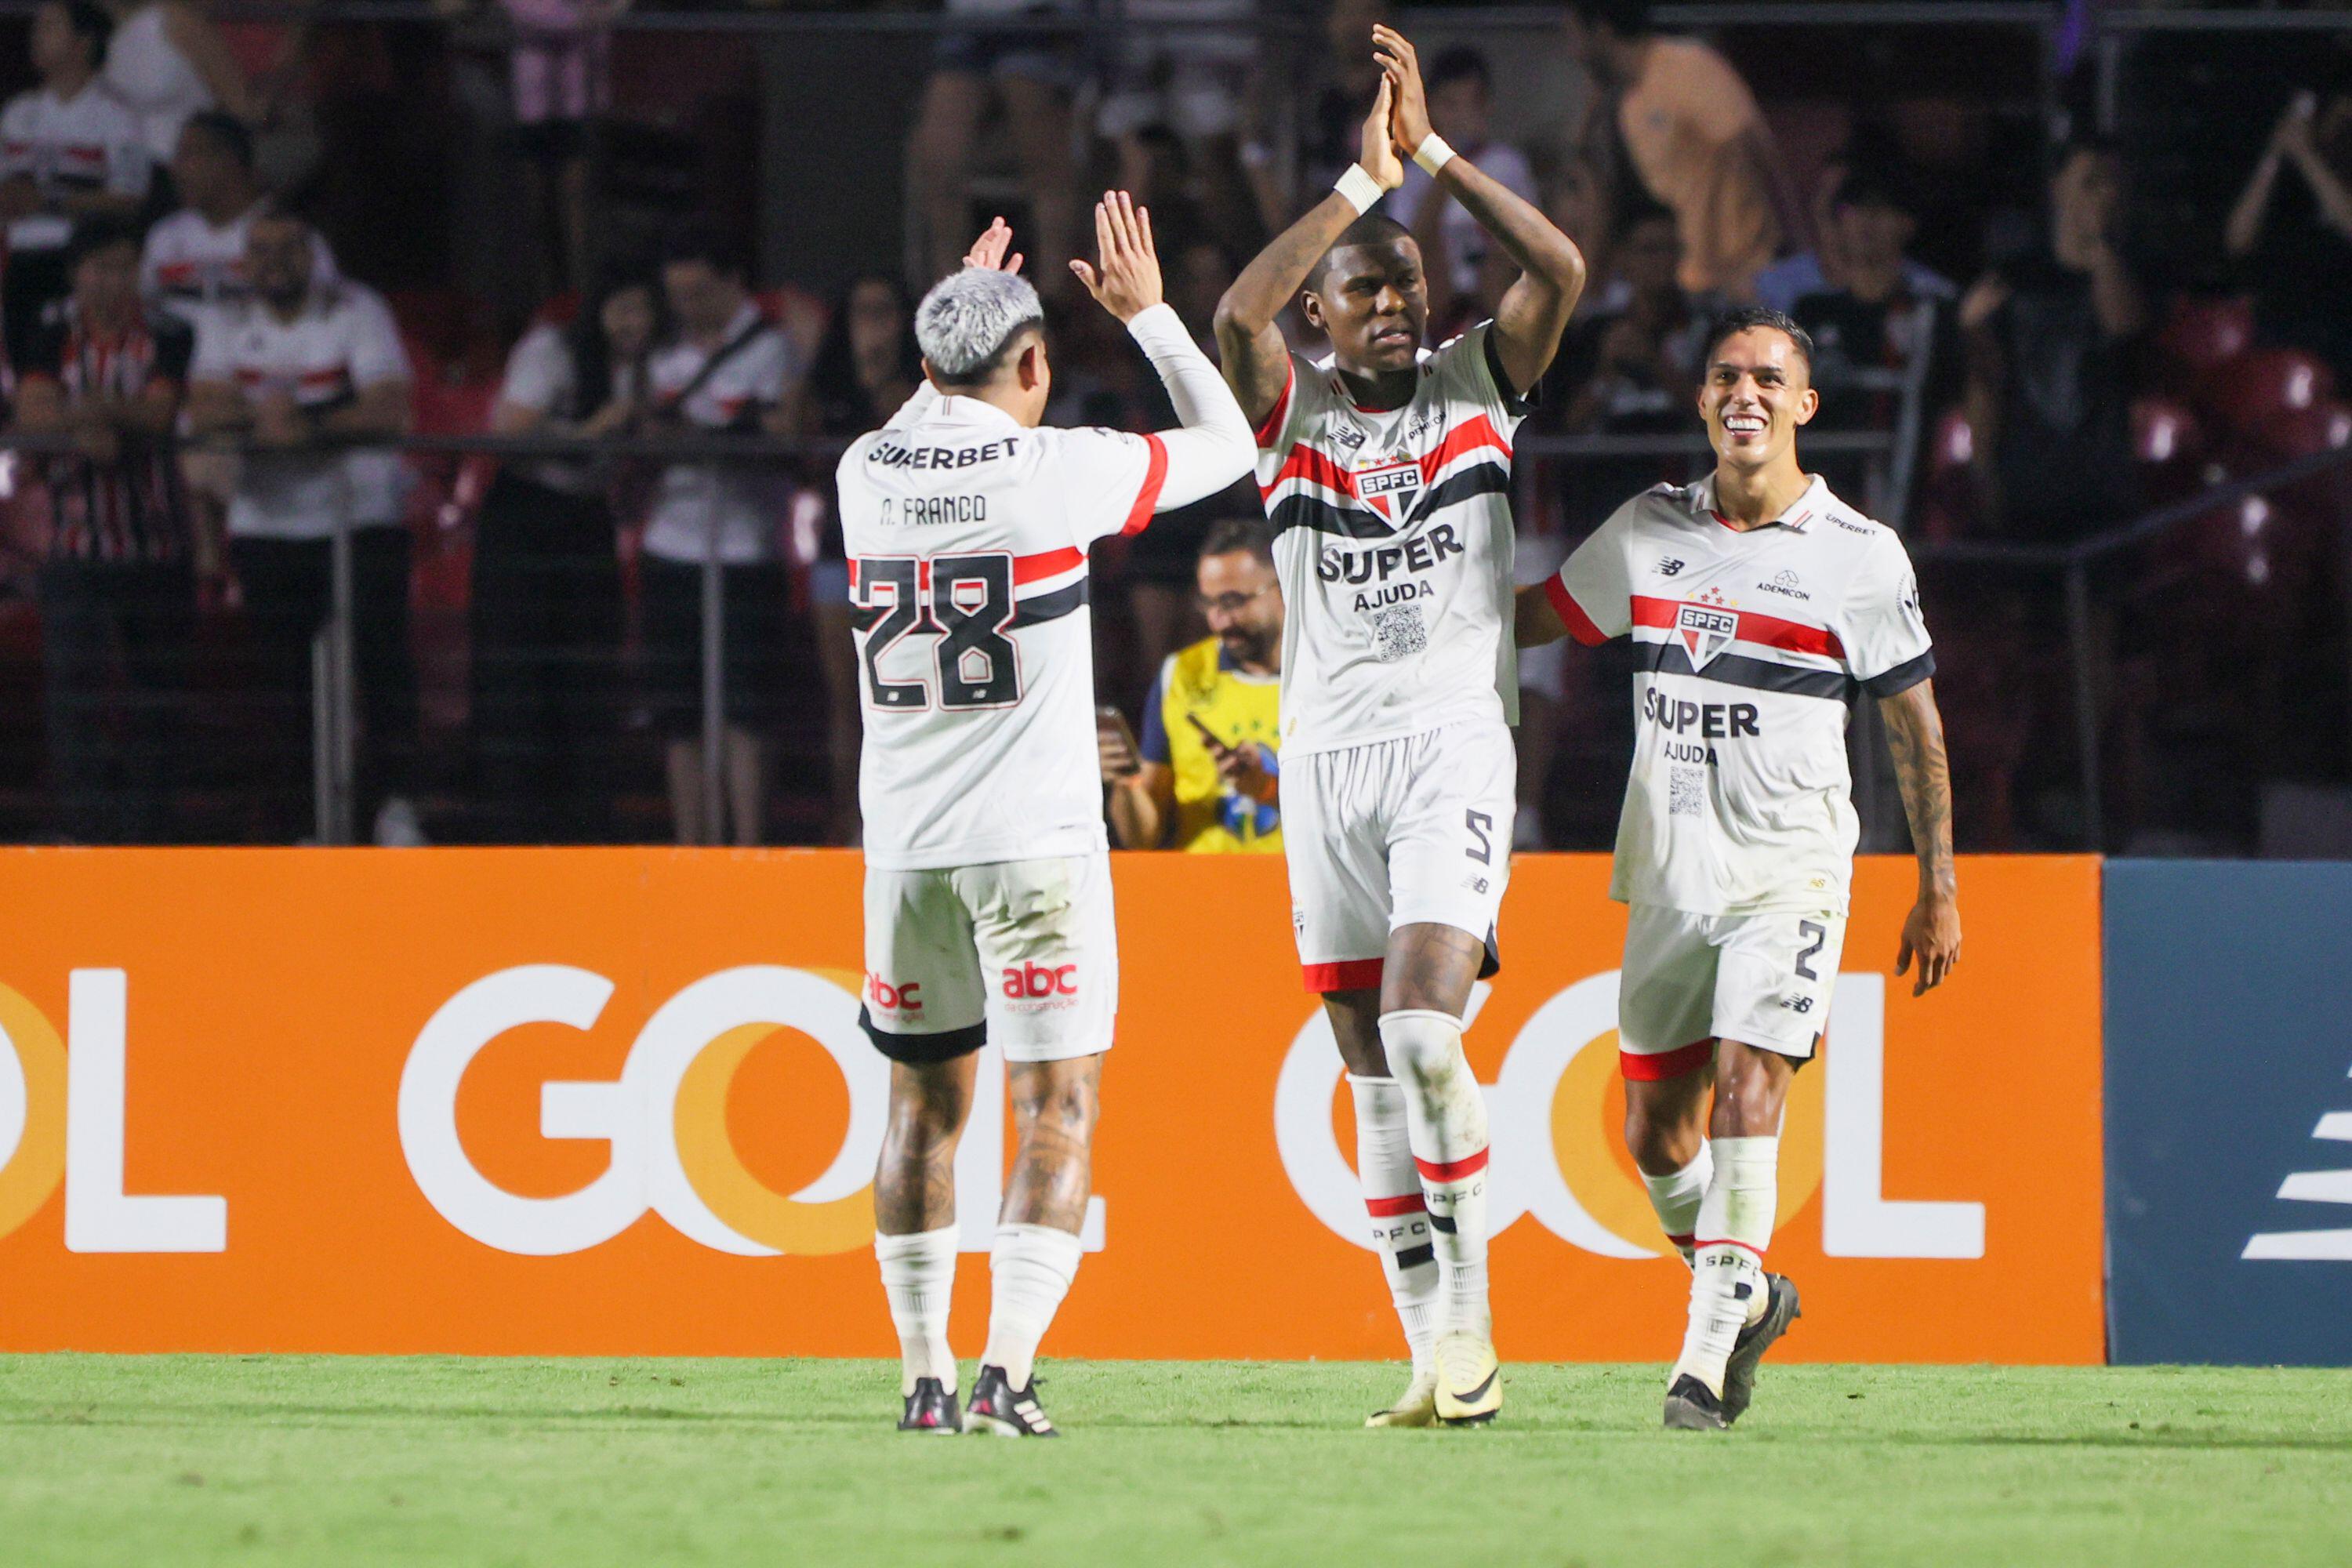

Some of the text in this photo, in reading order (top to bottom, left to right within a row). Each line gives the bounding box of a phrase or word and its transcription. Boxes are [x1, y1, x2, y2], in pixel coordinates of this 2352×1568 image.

[1363, 472, 1417, 495] SPFC
[903, 495, 986, 526] FRANCO
[1316, 524, 1465, 585] SUPER
[1353, 579, 1435, 613] AJUDA
[1756, 582, 1810, 602] ADEMICON
[855, 550, 1024, 713] 28
[1682, 610, 1732, 633] SPFC
[1644, 687, 1761, 739] SUPER
[1465, 808, 1493, 866] 5
[1795, 919, 1826, 982] 2
[1002, 960, 1078, 999] abc
[397, 963, 1105, 1257] GOL
[1274, 968, 1986, 1259] GOL
